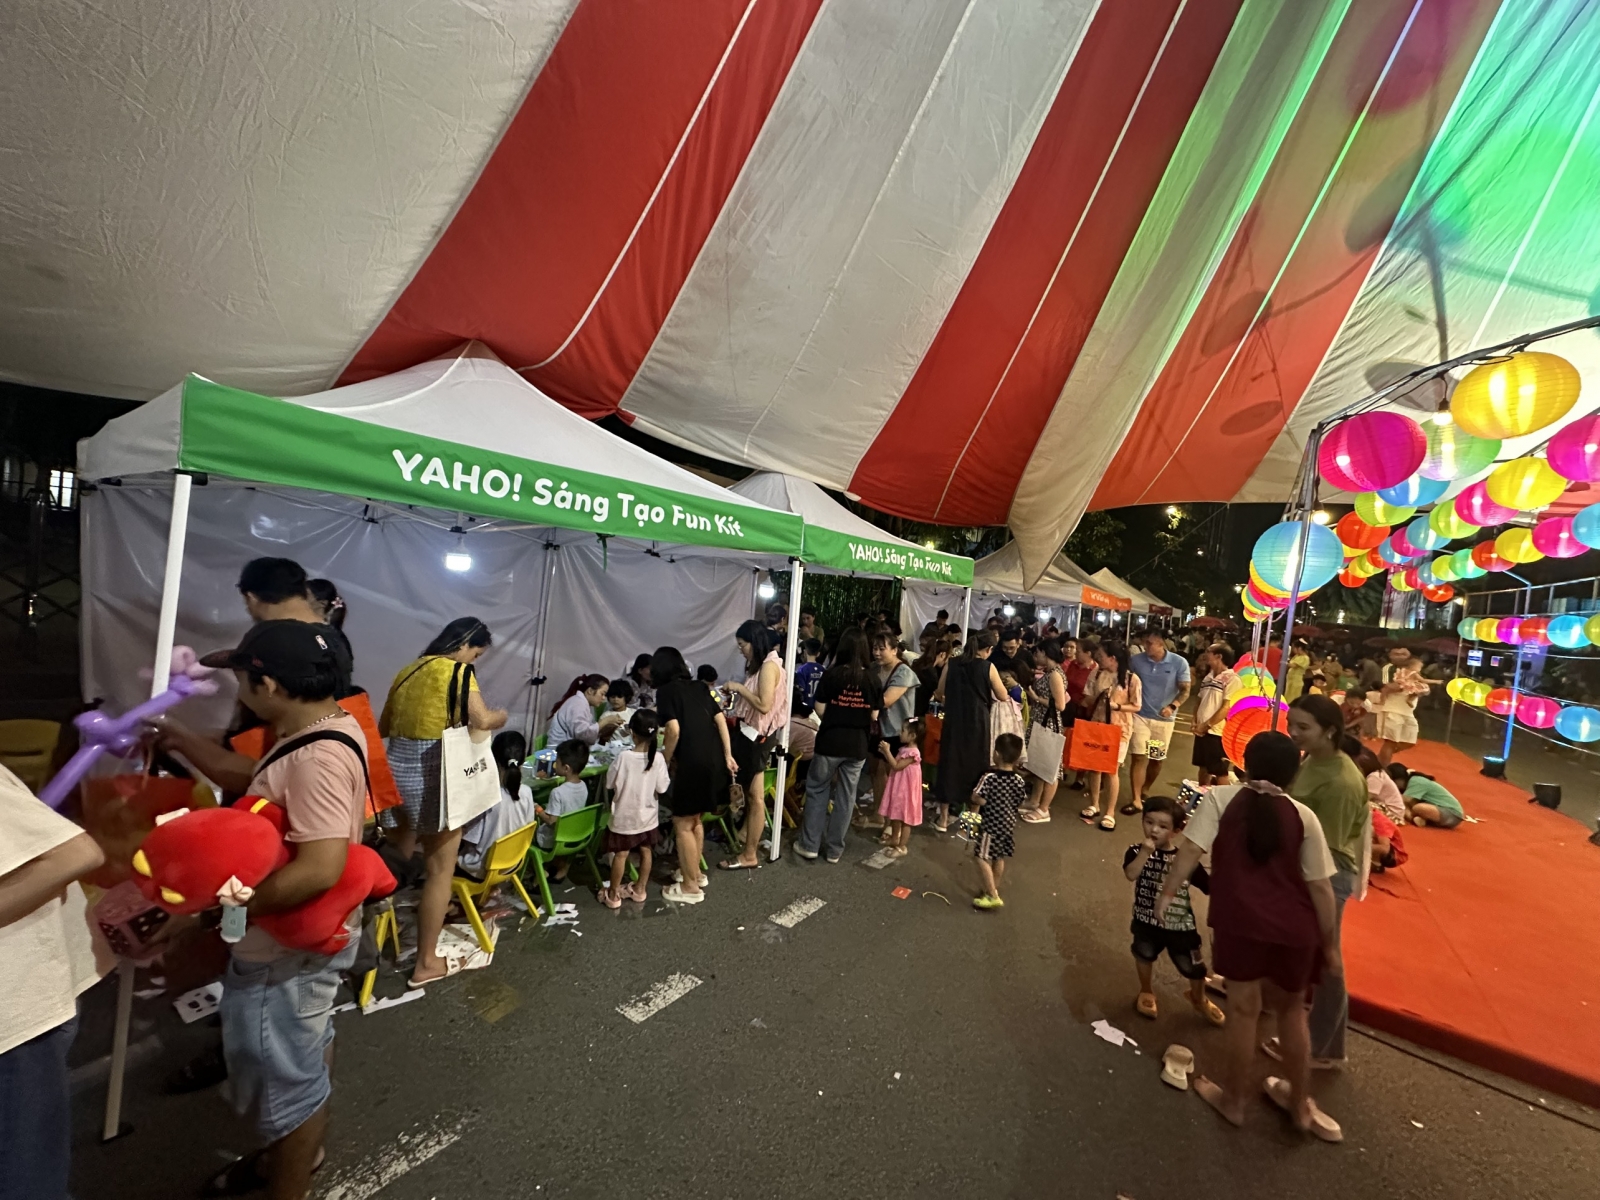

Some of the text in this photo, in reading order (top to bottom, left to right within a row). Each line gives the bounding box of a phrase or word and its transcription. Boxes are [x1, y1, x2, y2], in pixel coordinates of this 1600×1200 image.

[392, 449, 745, 538] YAHO! Sáng Tạo Fun Kit
[848, 542, 883, 563] YAHO!
[885, 548, 907, 571] Sáng
[908, 552, 924, 571] Tạo
[925, 556, 941, 573] Fun
